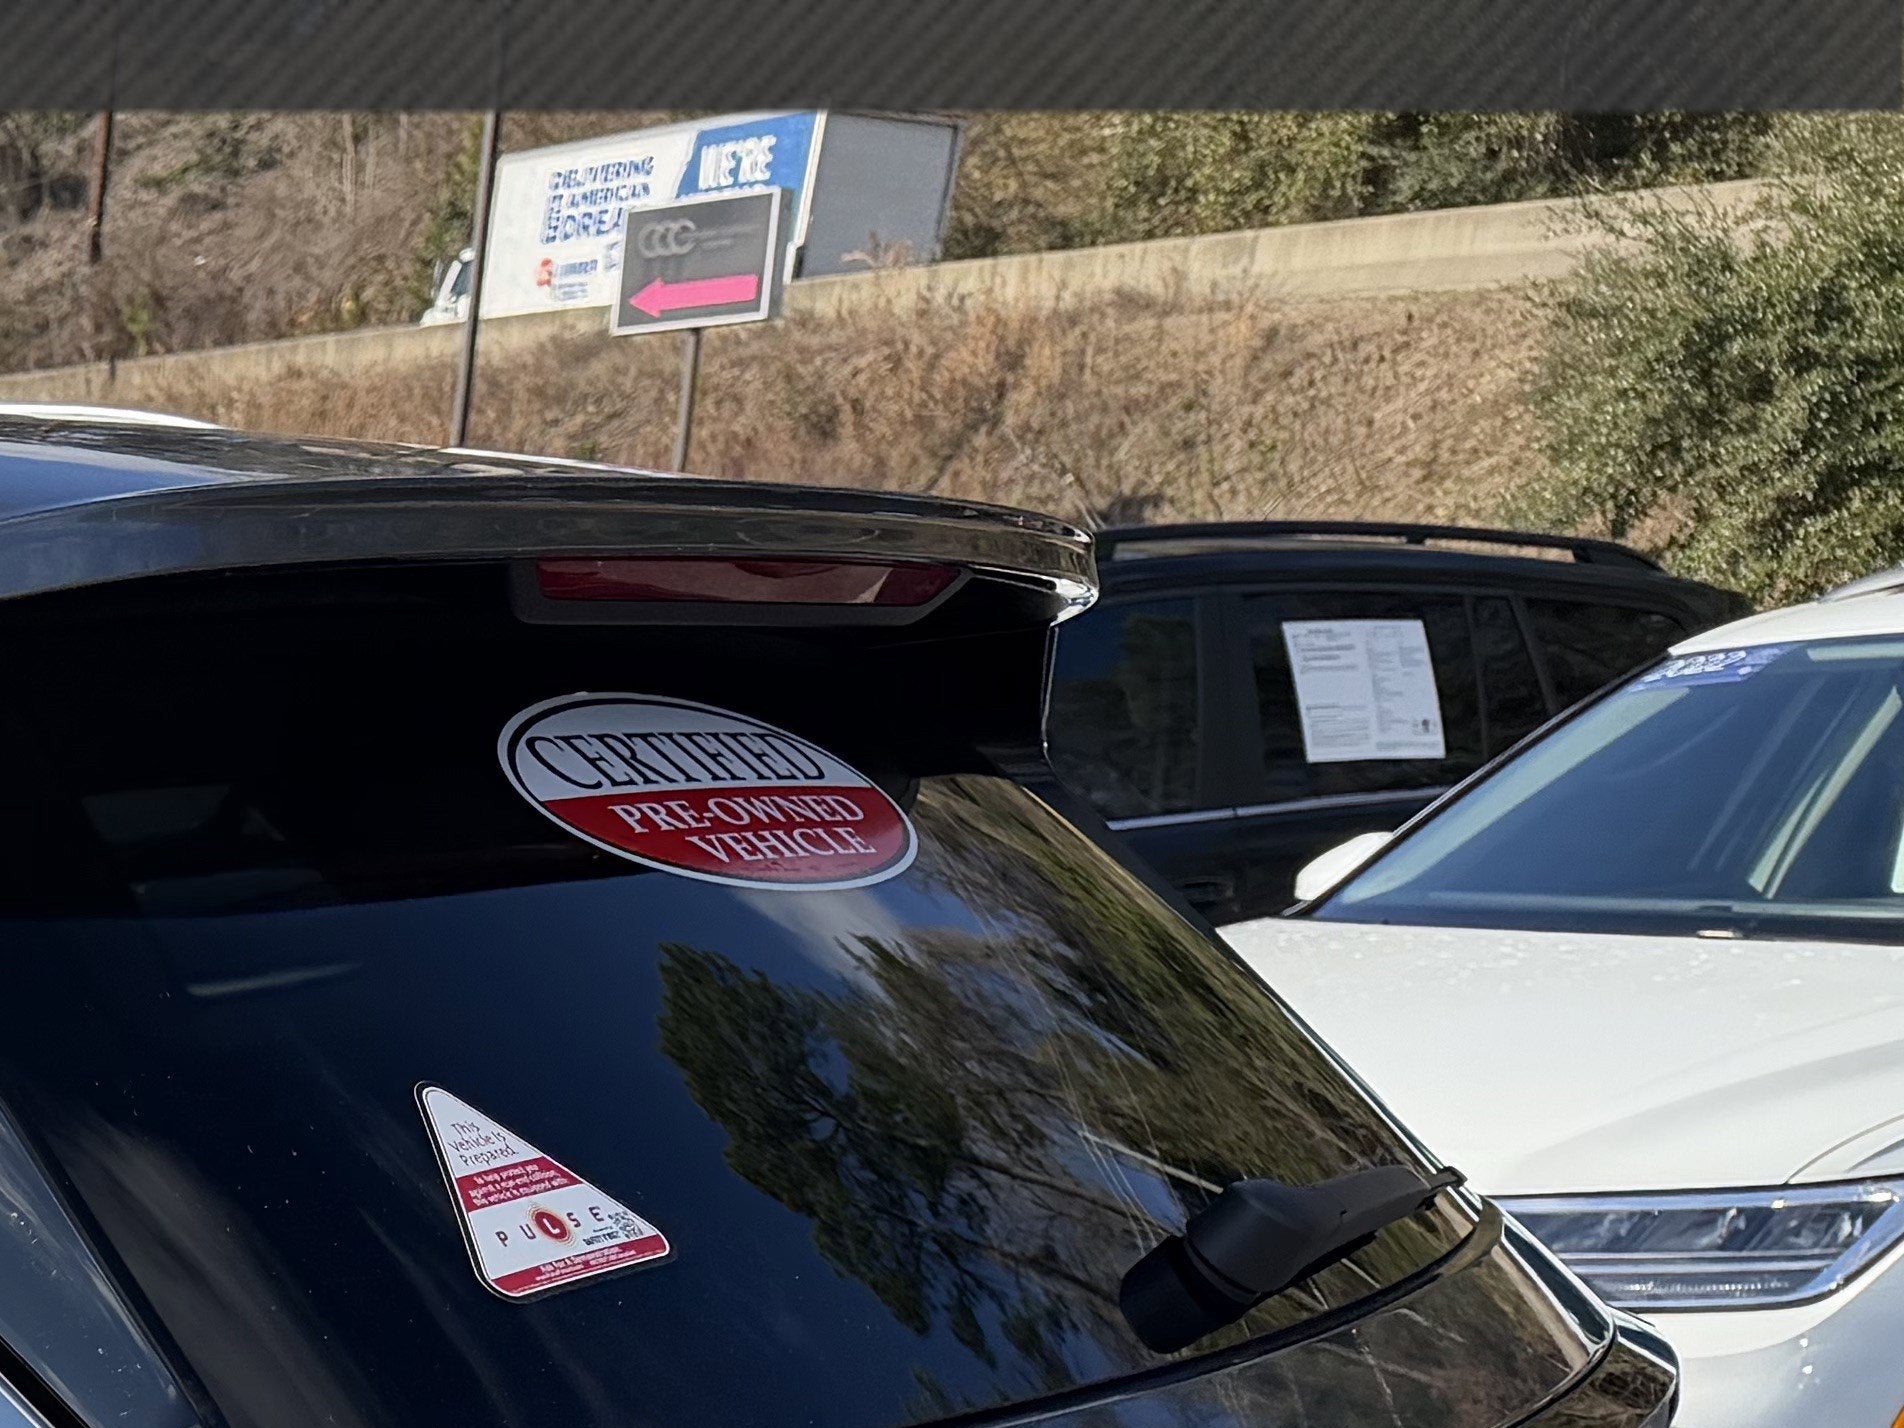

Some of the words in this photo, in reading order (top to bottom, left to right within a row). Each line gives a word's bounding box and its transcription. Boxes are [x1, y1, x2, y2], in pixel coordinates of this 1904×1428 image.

[524, 731, 827, 791] CERTIFIED
[607, 794, 865, 835] PRE-OWNED
[685, 826, 878, 864] VEHICLE
[448, 1134, 495, 1152] Vehicle
[450, 1120, 481, 1141] This
[495, 1206, 605, 1248] PULSE
